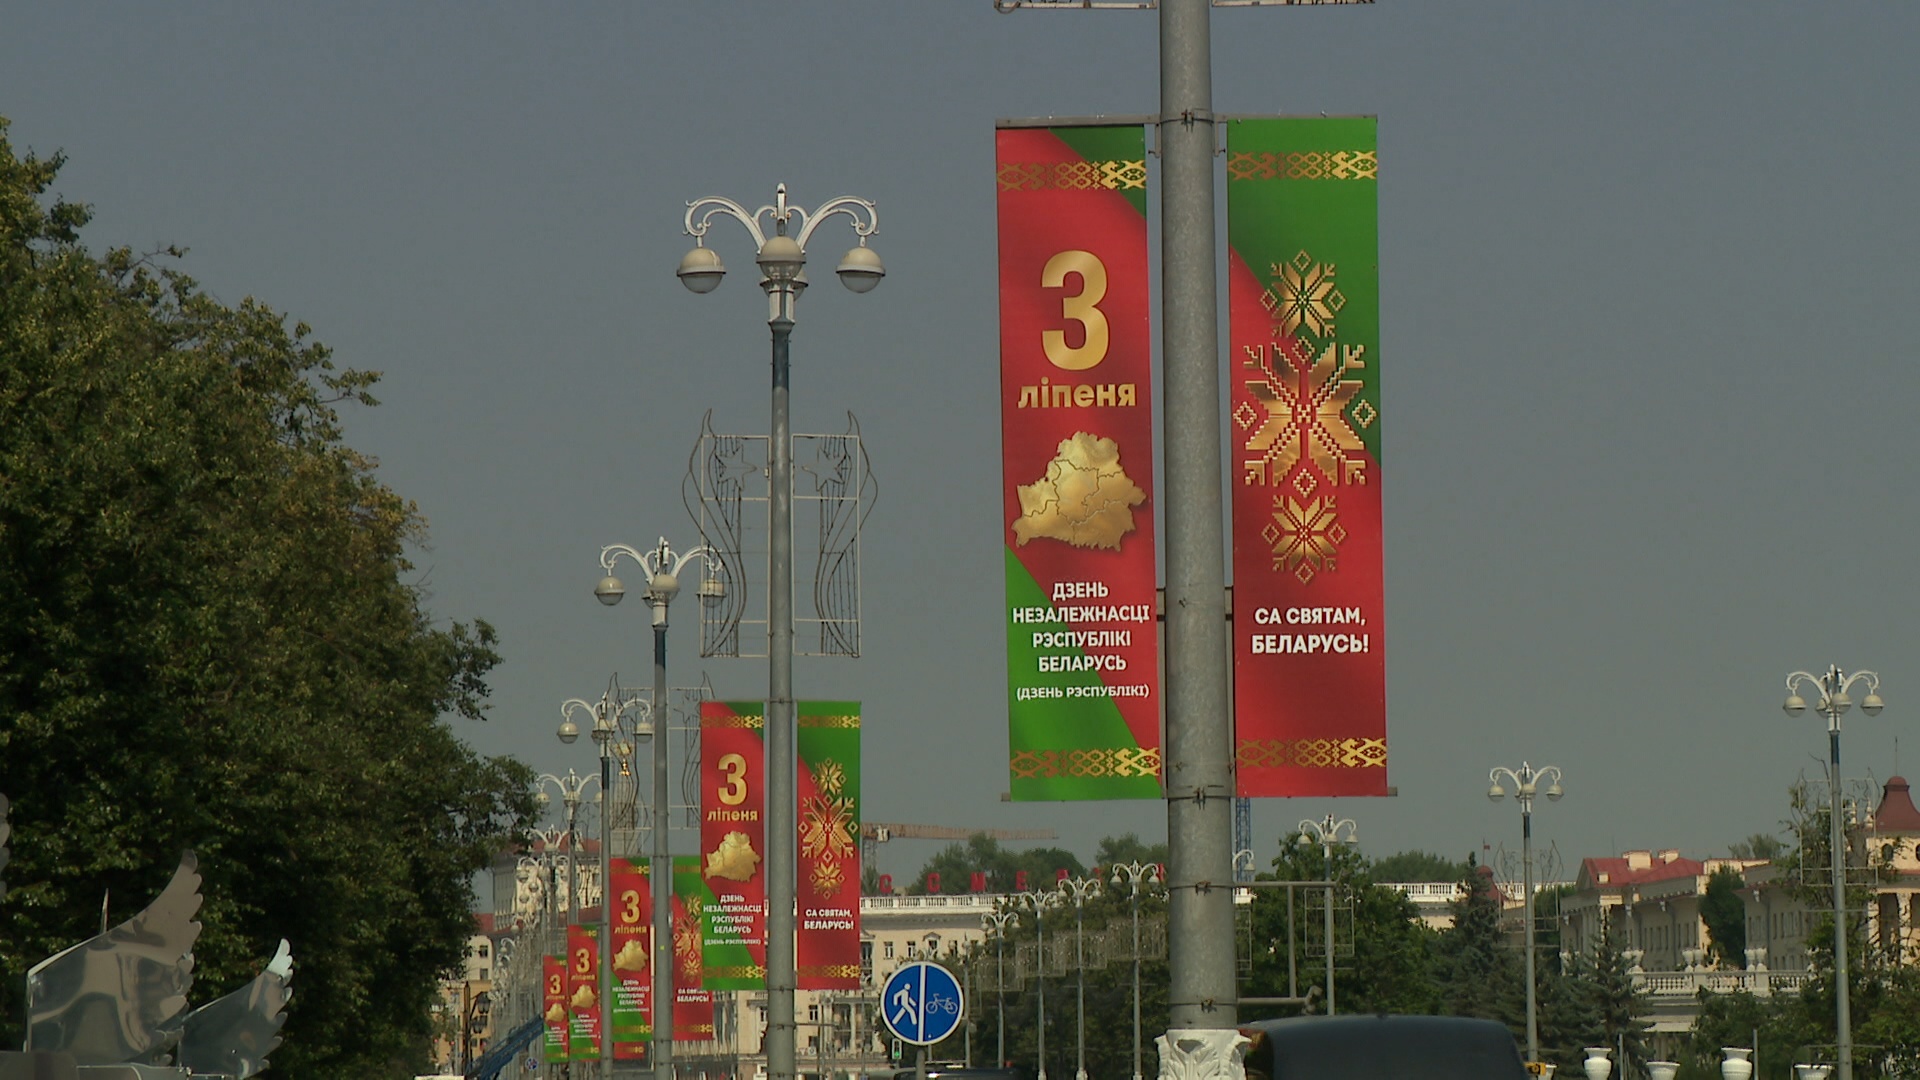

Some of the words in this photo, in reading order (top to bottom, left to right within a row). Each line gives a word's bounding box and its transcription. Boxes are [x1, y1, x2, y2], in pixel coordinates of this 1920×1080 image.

[1041, 250, 1109, 370] 3
[1018, 377, 1135, 408] ліпеня
[1053, 582, 1108, 601] ДЗЕНЬ
[1013, 605, 1149, 623] НЕЗАЛЕЖНАСЦІ
[1255, 608, 1281, 624] СА
[1286, 607, 1365, 625] СВЯТАМ,
[1033, 631, 1130, 647] РЭСПУБЛІКІ
[1252, 634, 1368, 653] БЕЛАРУСЬ!
[1039, 655, 1126, 672] БЕЛАРУСЬ
[1017, 687, 1063, 701] (ДЗЕНЬ
[1067, 684, 1149, 698] РЭСПУБЛІКІ)
[718, 753, 747, 805] 3
[708, 808, 757, 821] ліпеня
[621, 890, 639, 923] 3
[720, 895, 744, 903] ДЗЕНЬ
[704, 905, 761, 913] НЕЗАЛЕЖНАСЦІ
[806, 909, 817, 917] СА
[819, 909, 852, 917] СВЯТАМ,
[712, 915, 753, 923] РЭСПУБЛІКІ
[804, 920, 853, 929] БЕЛАРУСЬ!
[576, 948, 589, 973] 3
